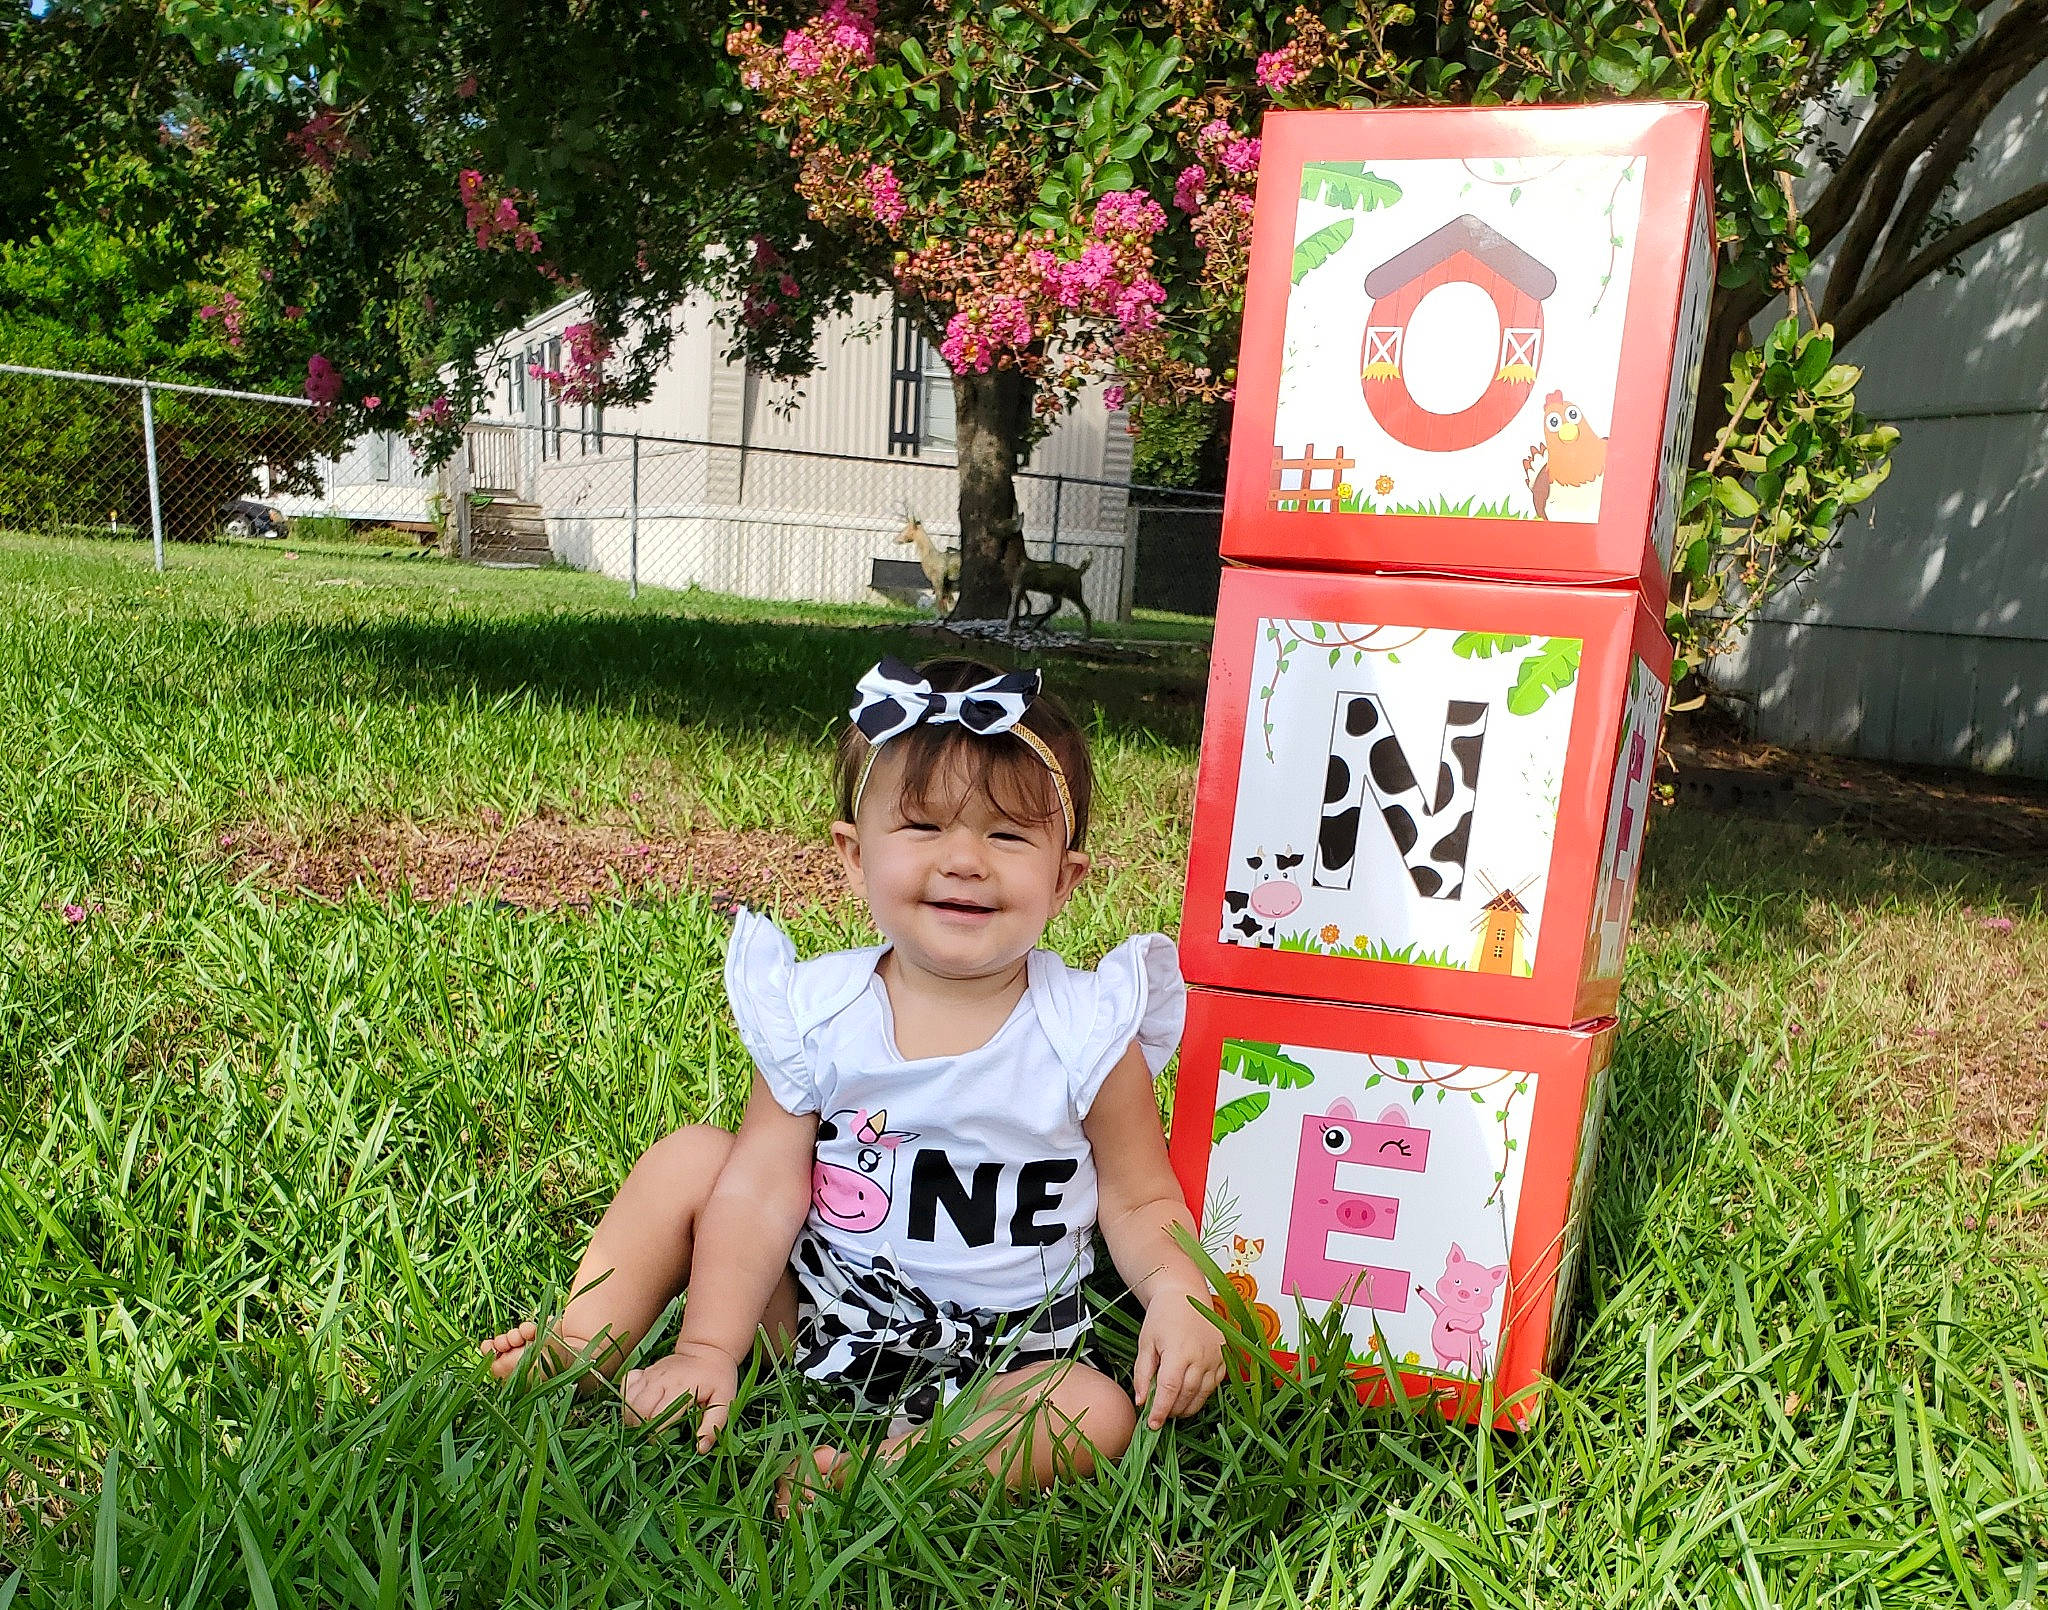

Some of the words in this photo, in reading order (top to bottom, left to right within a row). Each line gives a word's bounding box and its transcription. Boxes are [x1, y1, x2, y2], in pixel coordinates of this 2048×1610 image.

[1360, 243, 1546, 453] O
[1312, 691, 1489, 901] N
[1281, 1114, 1431, 1314] E
